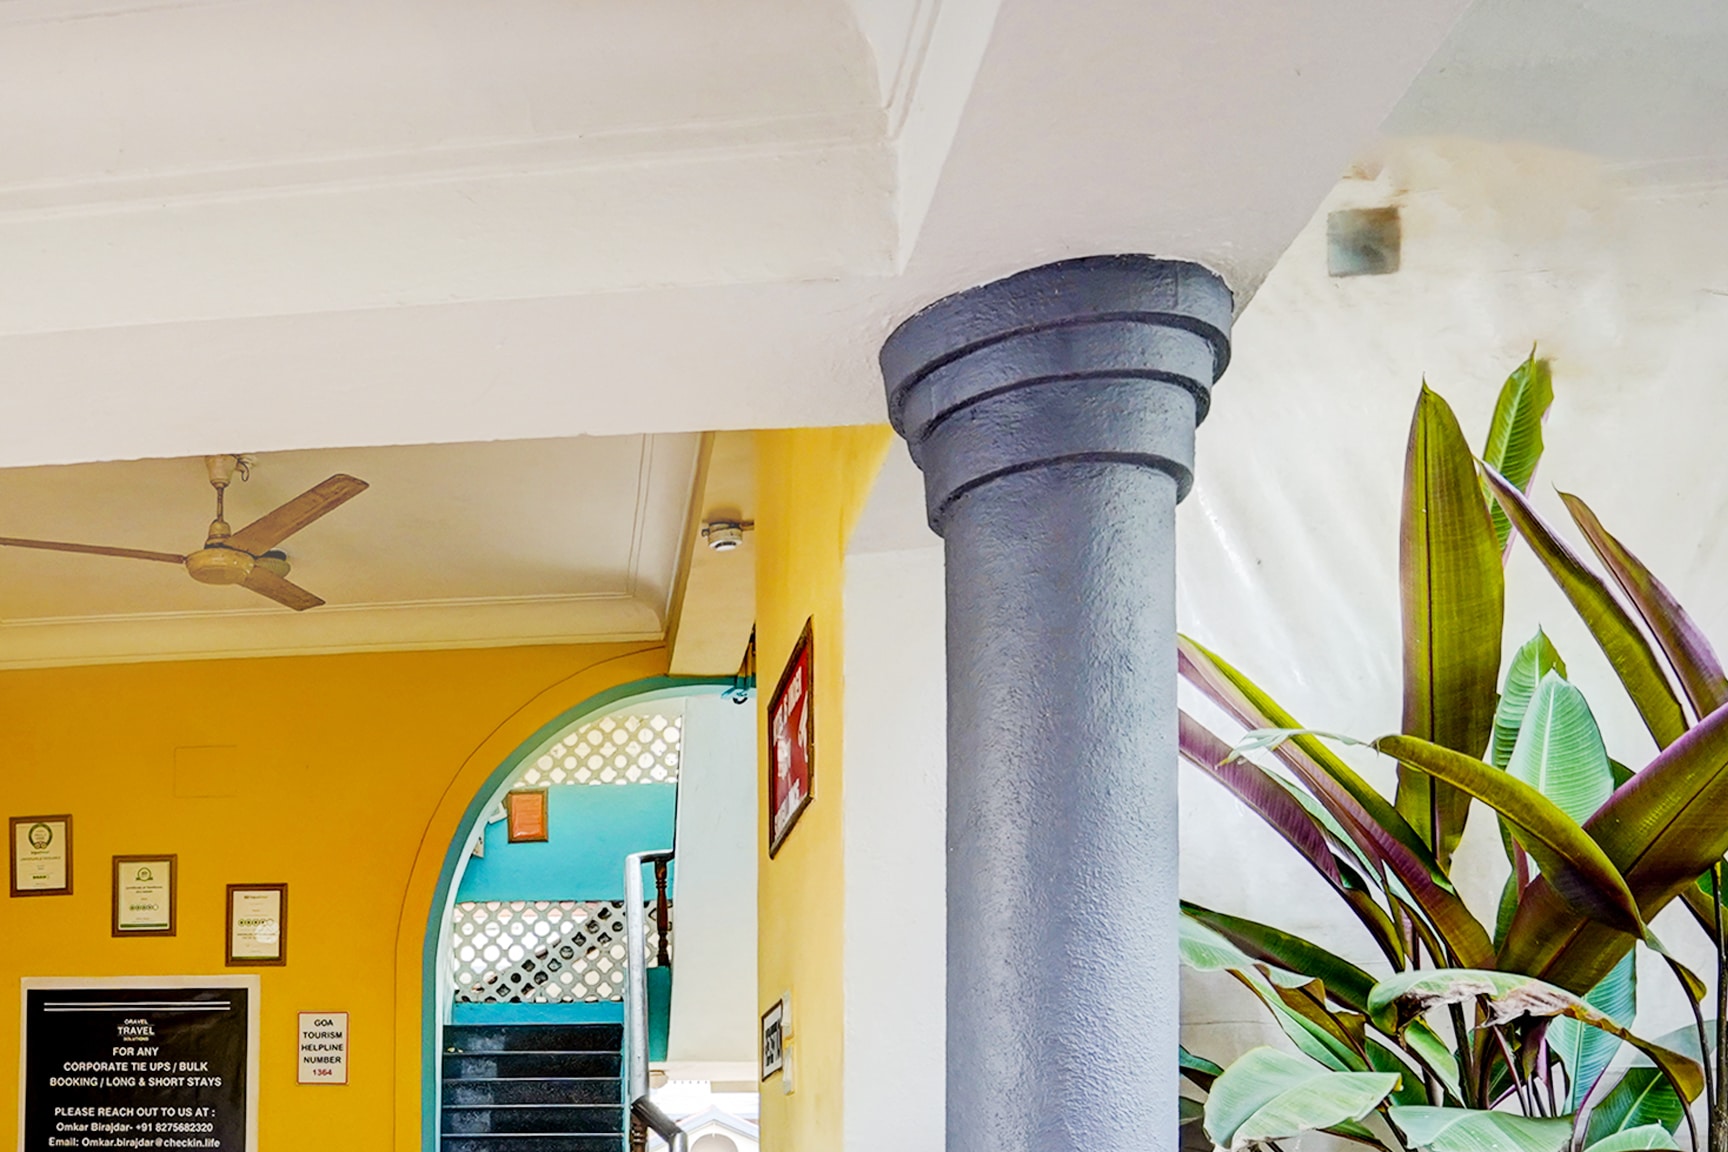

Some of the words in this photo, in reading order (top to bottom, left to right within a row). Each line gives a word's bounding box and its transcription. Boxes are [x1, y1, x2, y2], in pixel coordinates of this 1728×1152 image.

[314, 1019, 334, 1027] GOA
[117, 1026, 155, 1036] TRAVEL
[303, 1031, 343, 1039] TOURISM
[113, 1047, 134, 1056] FOR
[137, 1047, 159, 1056] ANY
[301, 1044, 344, 1052] HELPLINE
[303, 1056, 342, 1064] NUMBER
[63, 1062, 128, 1071] CORPORATE
[131, 1062, 147, 1071] TIE
[149, 1062, 171, 1071] UPS
[179, 1062, 208, 1072] BULK
[50, 1077, 98, 1087] BOOKING
[106, 1077, 136, 1087] LONG
[138, 1077, 146, 1087] &
[148, 1077, 185, 1087] SHORT
[187, 1077, 222, 1087] STAYS
[54, 1107, 95, 1117] PLEASE
[98, 1107, 133, 1117] REACH
[136, 1107, 157, 1117] OUT
[161, 1107, 176, 1117] TO
[178, 1107, 193, 1117] US
[195, 1108, 209, 1117] AT
[56, 1122, 89, 1132] Omkar
[135, 1123, 153, 1132] +91
[48, 1137, 79, 1147] Email:
